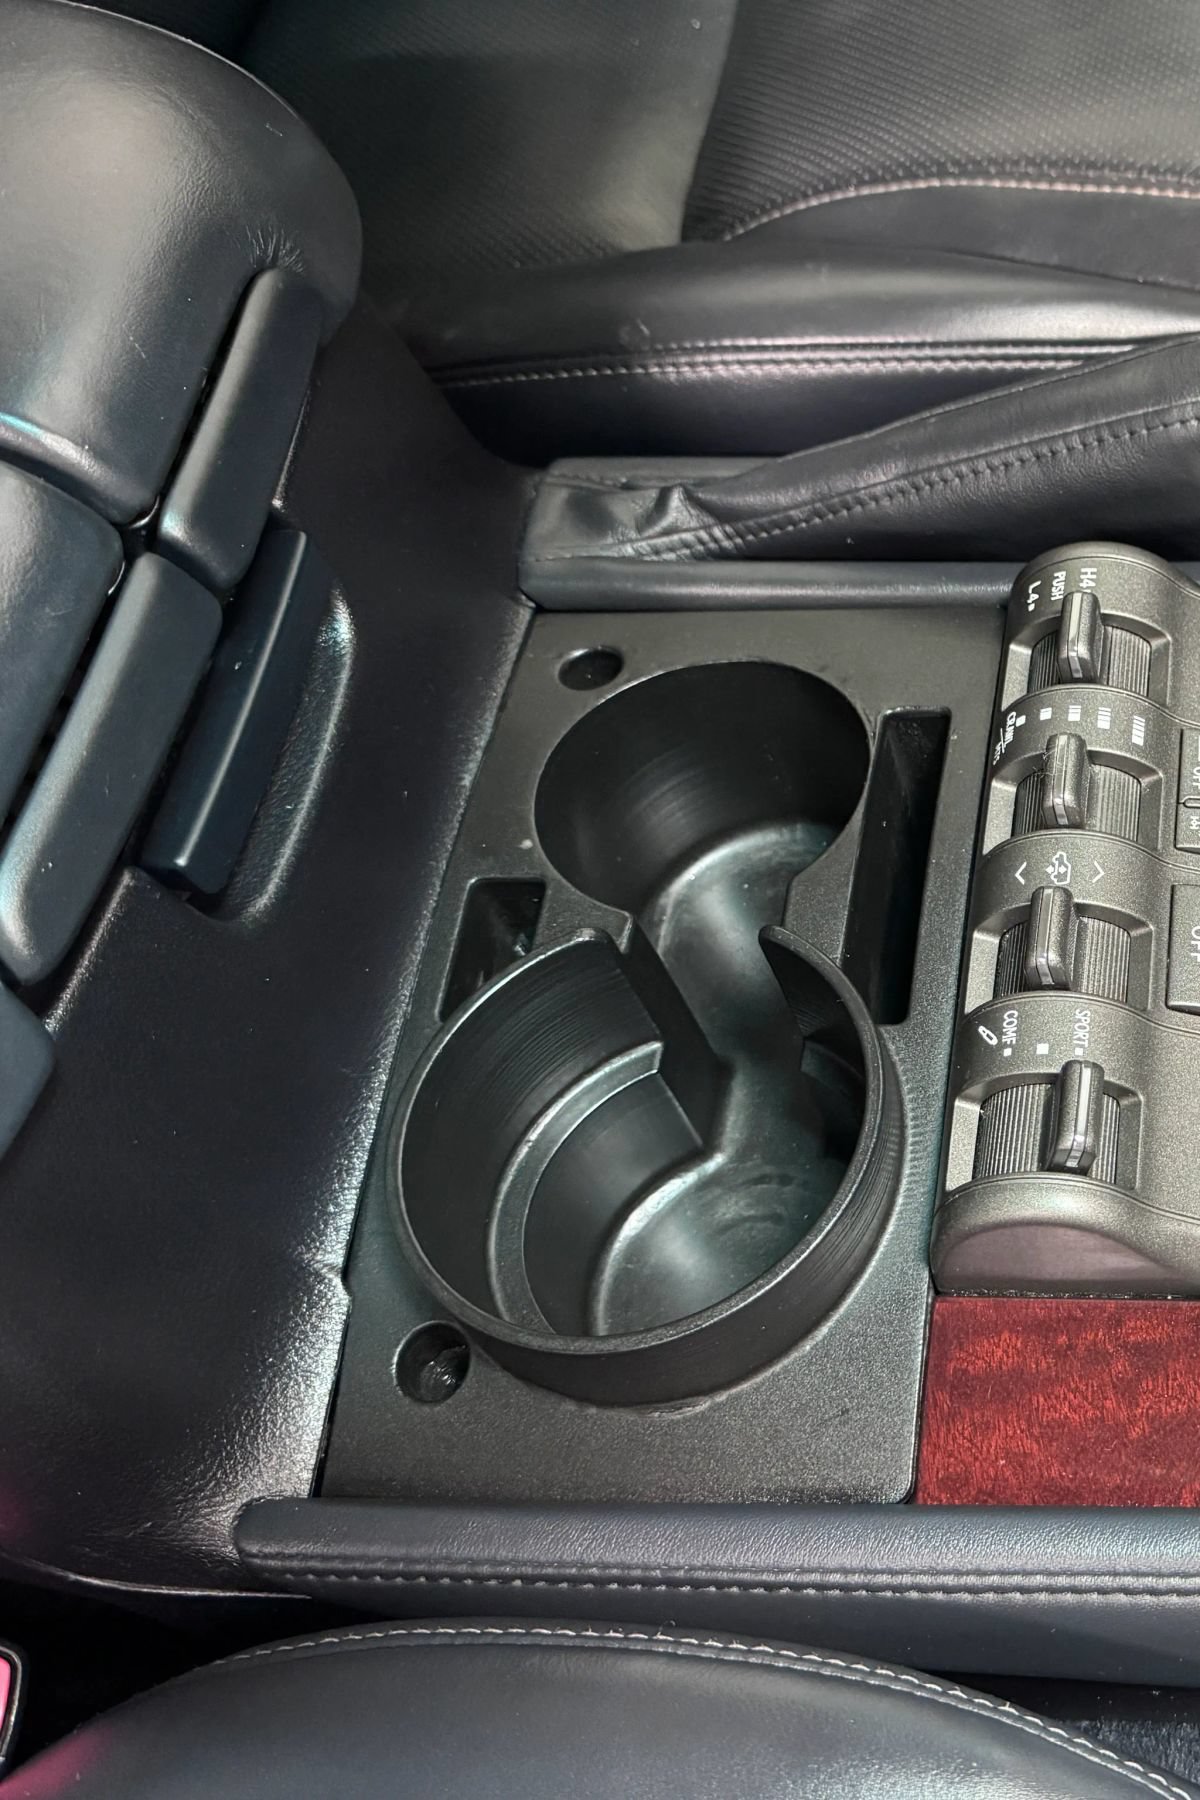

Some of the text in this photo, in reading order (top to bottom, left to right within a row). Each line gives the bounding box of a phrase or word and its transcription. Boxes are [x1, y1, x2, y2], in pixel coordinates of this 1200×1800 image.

[1027, 580, 1042, 604] L4
[1051, 570, 1067, 600] PUSH
[1002, 1010, 1018, 1045] COMF
[1073, 1008, 1091, 1048] SPORT
